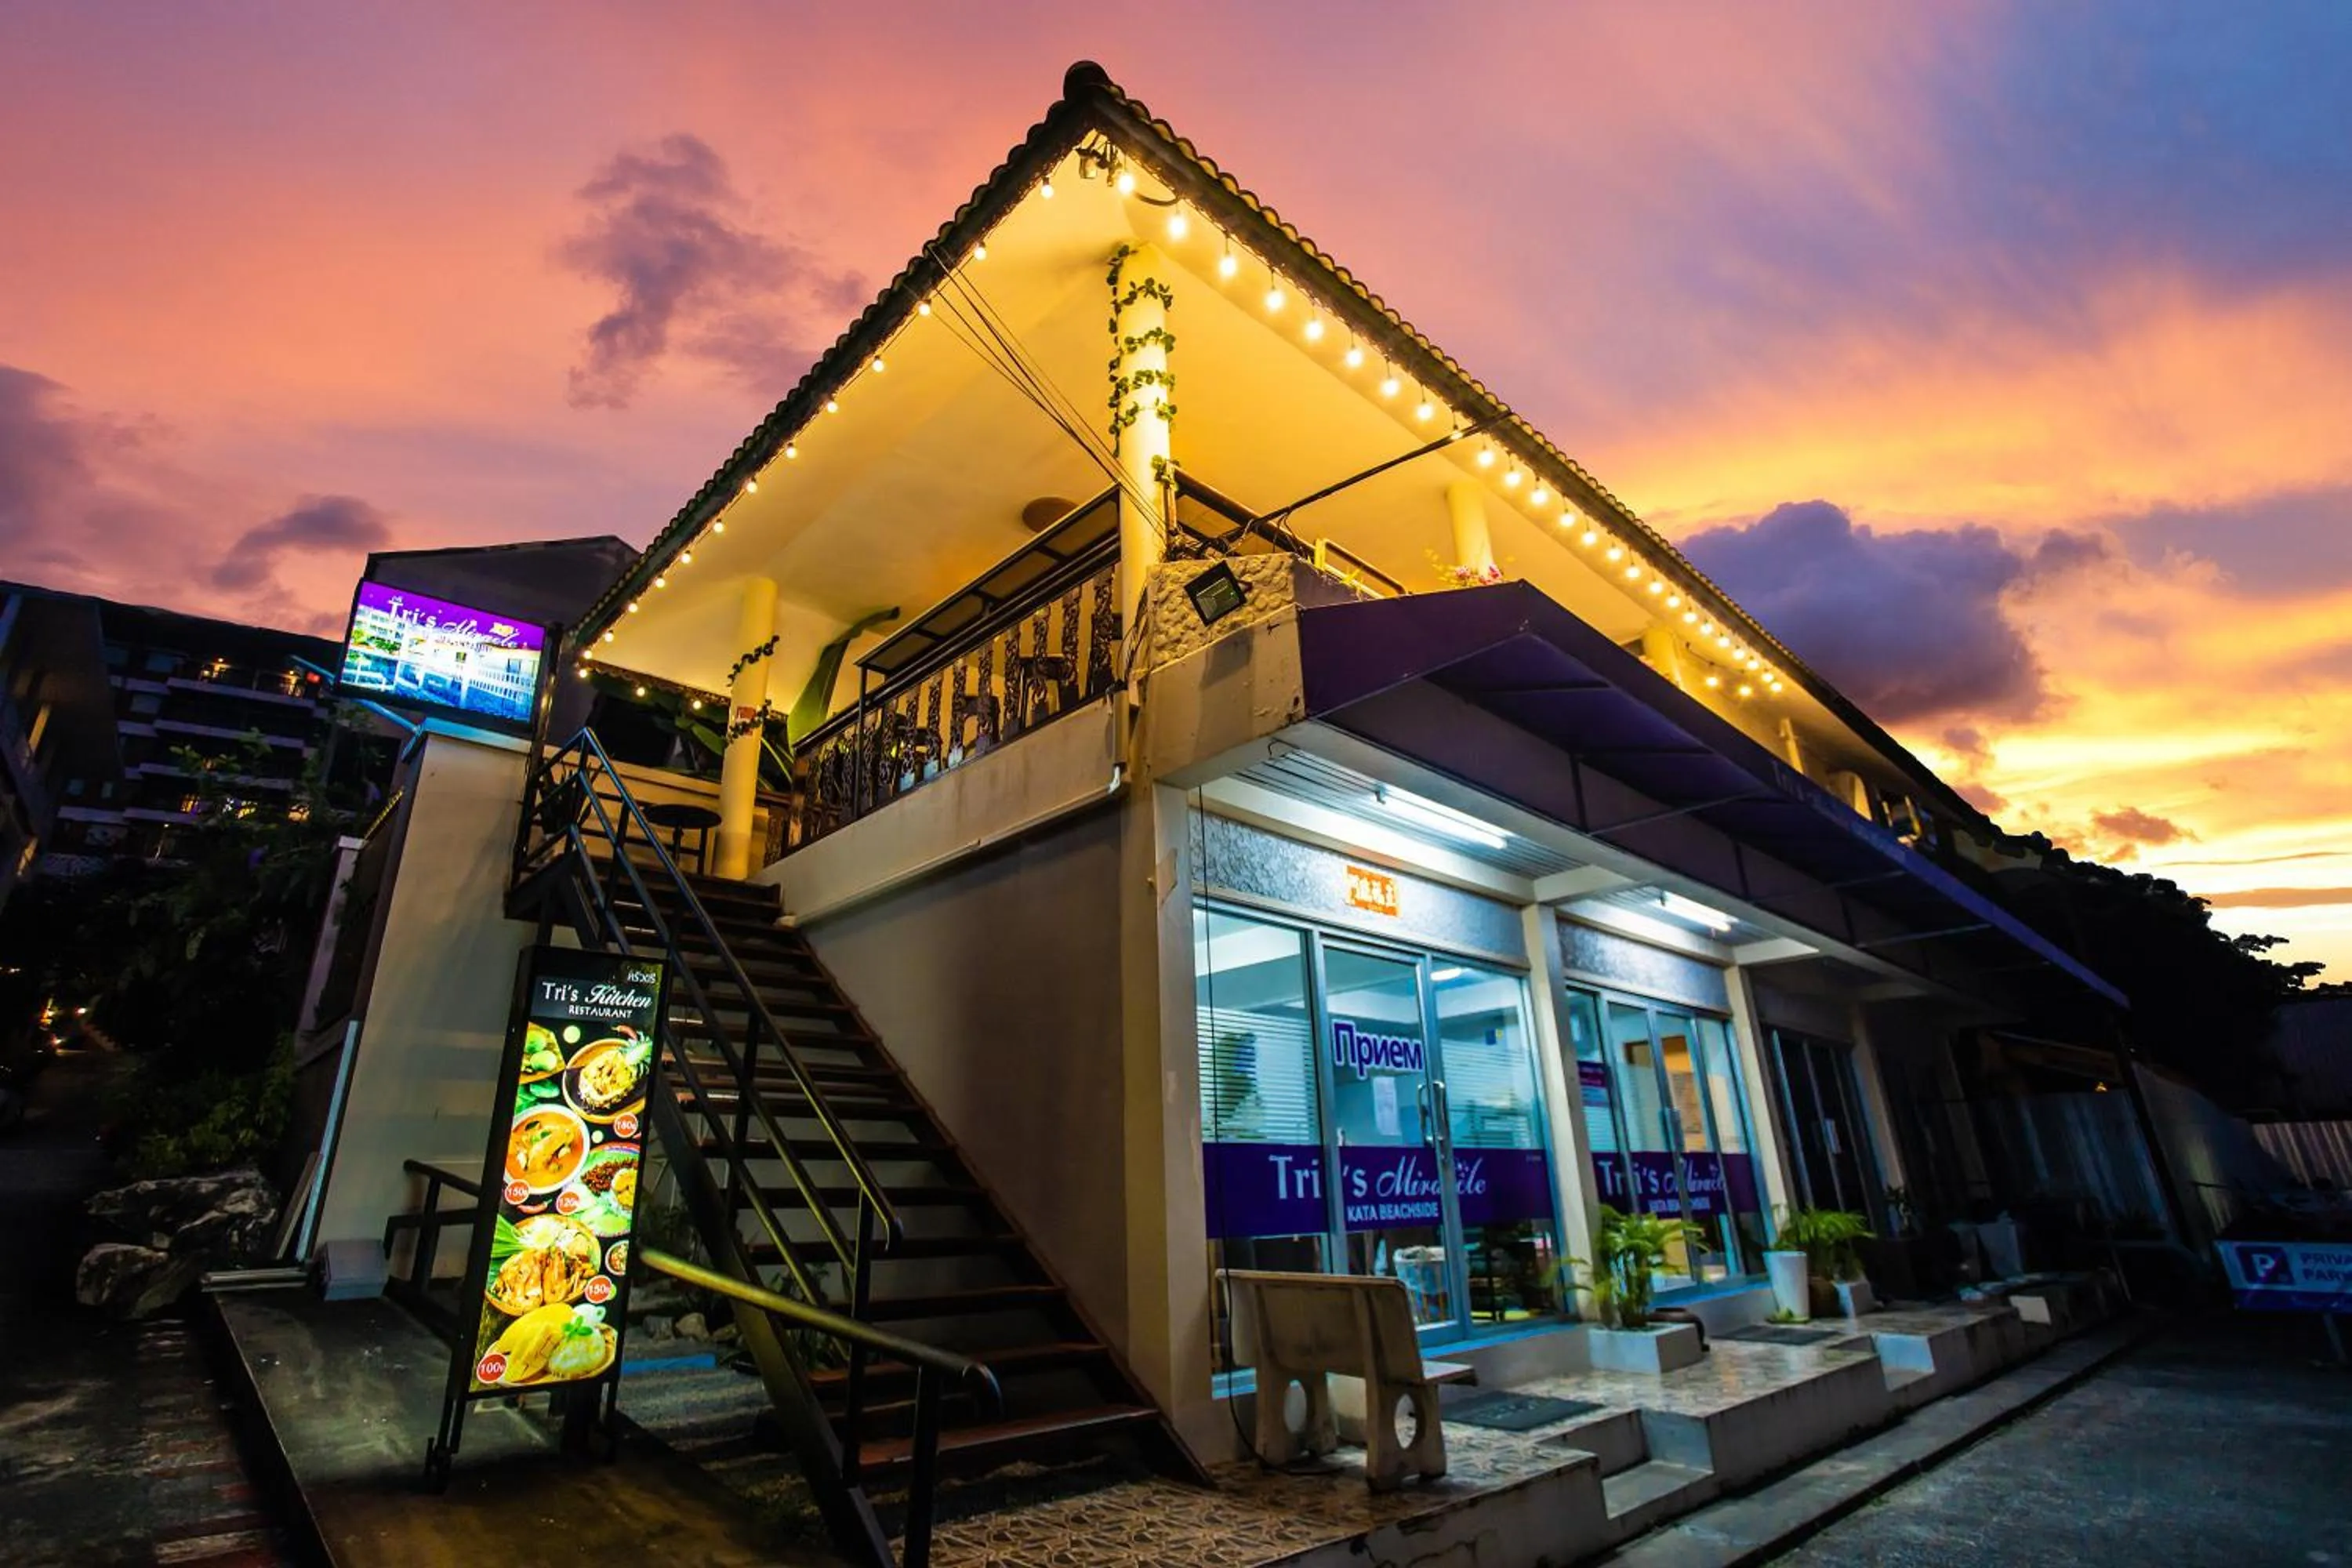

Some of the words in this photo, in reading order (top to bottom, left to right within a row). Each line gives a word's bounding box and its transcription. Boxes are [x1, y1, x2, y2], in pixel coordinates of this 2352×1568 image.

[388, 599, 436, 626] Tri's
[542, 982, 579, 1003] Tri's
[585, 983, 652, 1009] Kitchen
[568, 1004, 633, 1018] RESTAURANT
[1334, 1022, 1424, 1077] Прием
[1347, 1205, 1377, 1222] KATA
[1379, 1202, 1439, 1221] BEACHSIDE
